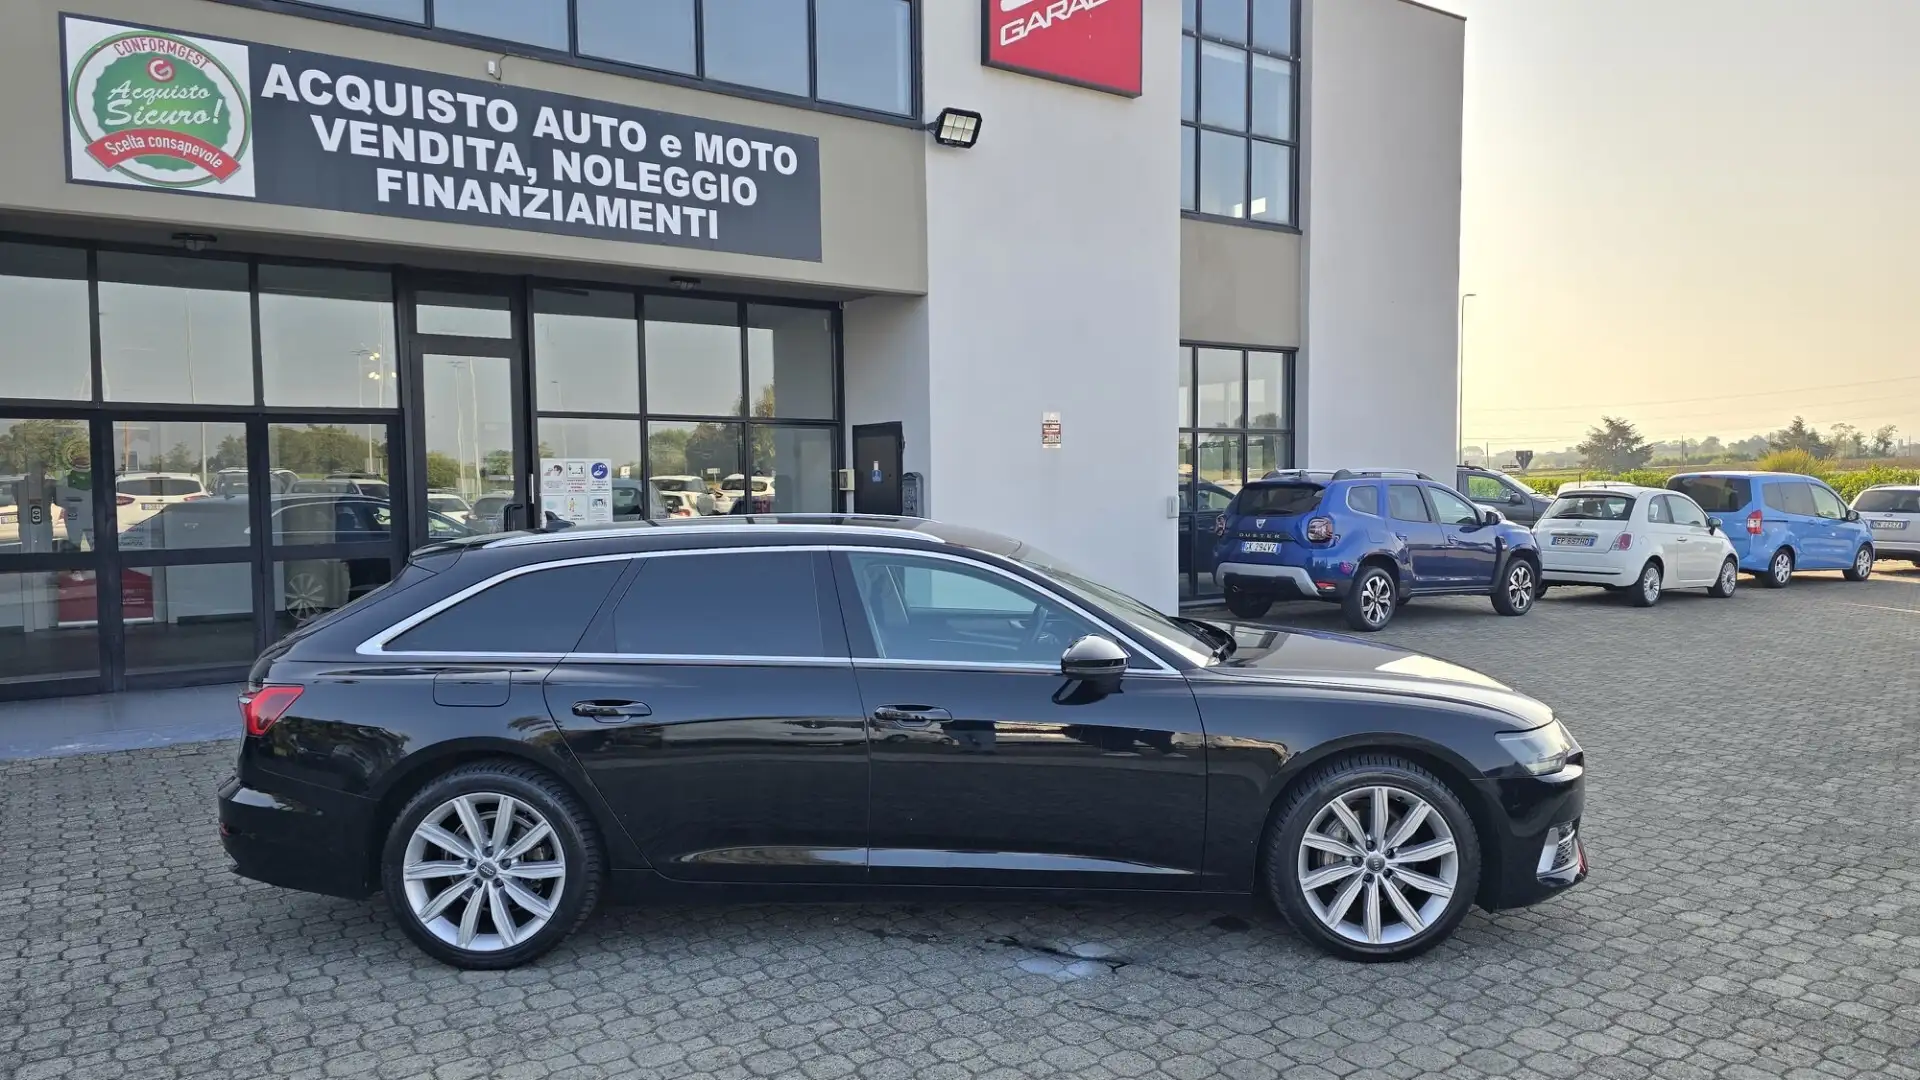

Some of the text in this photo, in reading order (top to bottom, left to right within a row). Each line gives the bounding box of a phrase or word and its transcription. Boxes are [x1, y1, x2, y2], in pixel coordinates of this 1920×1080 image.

[113, 36, 210, 70] CONFORMGEST
[108, 79, 211, 103] Acquisto
[105, 99, 222, 126] Sicuro!
[261, 63, 798, 176] ACQUISTO AUTO e MOTO
[104, 134, 223, 169] Scelta consapevole
[310, 114, 758, 207] VENDITA, NOLEGGIO
[376, 169, 719, 240] FINANZIAMENTI
